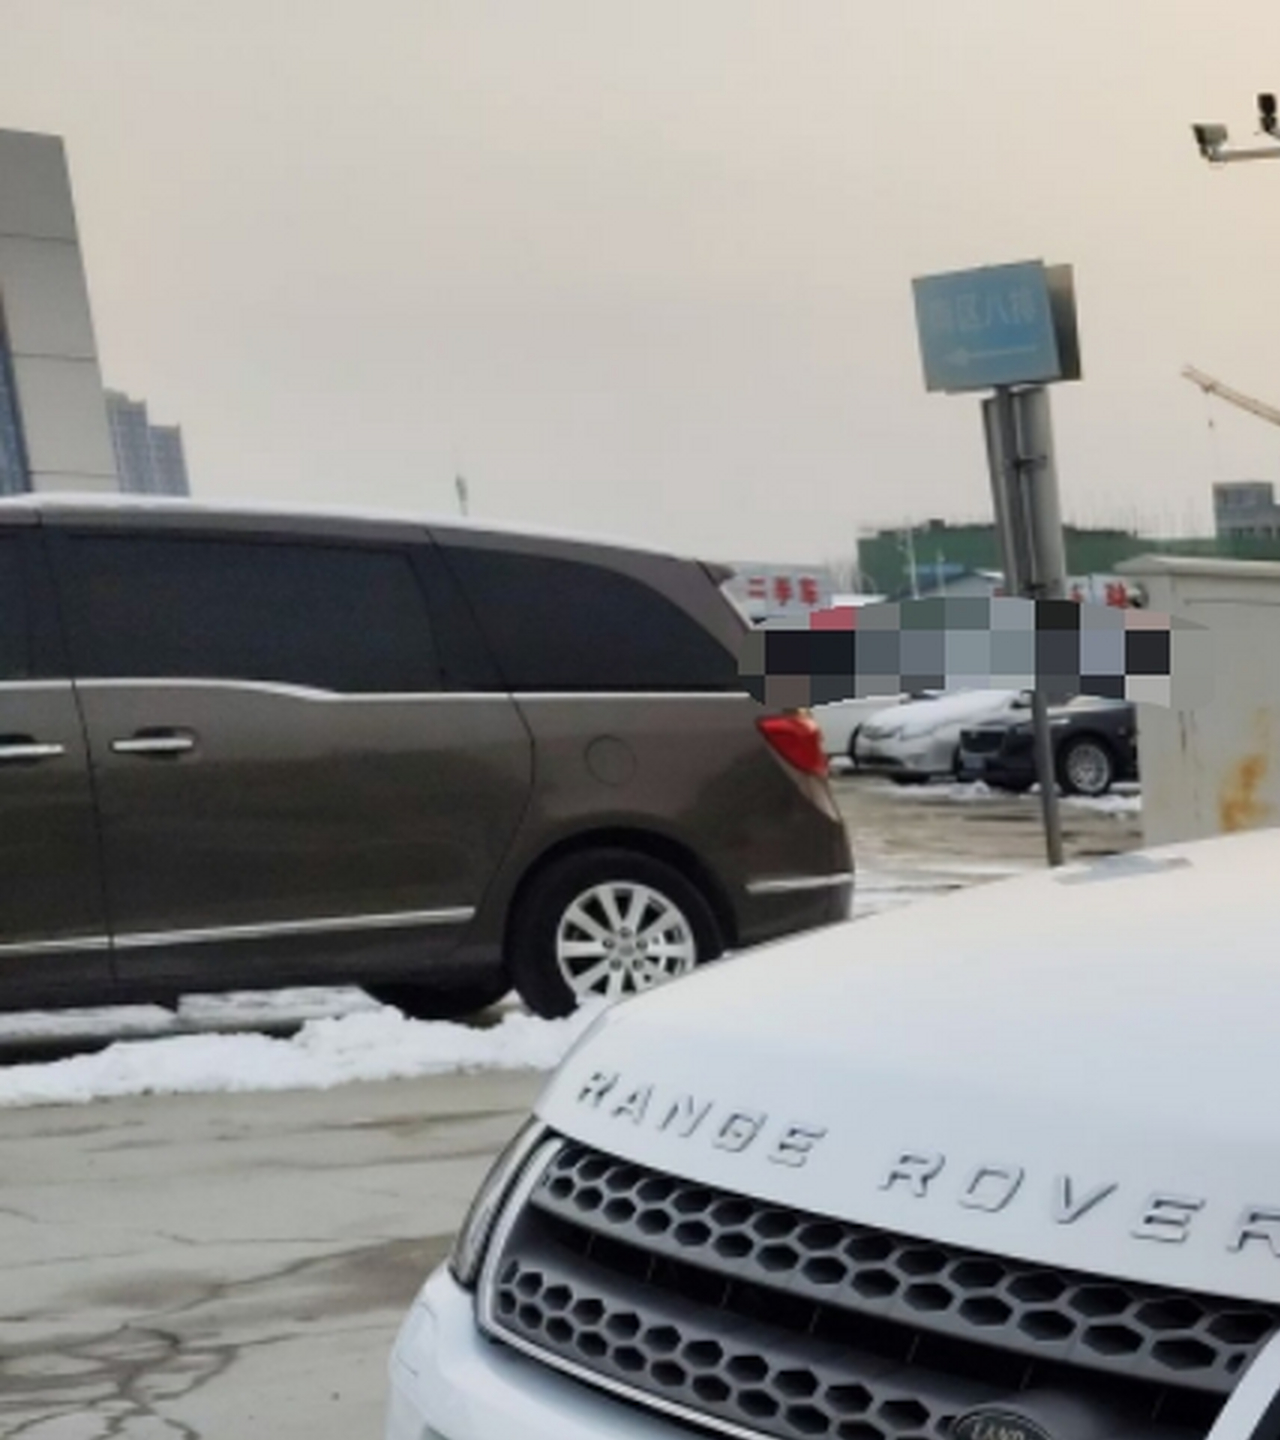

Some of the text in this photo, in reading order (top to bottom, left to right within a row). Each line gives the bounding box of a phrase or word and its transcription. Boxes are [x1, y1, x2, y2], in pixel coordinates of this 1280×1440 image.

[747, 575, 819, 607] 二手车
[576, 1069, 829, 1167] RANGE
